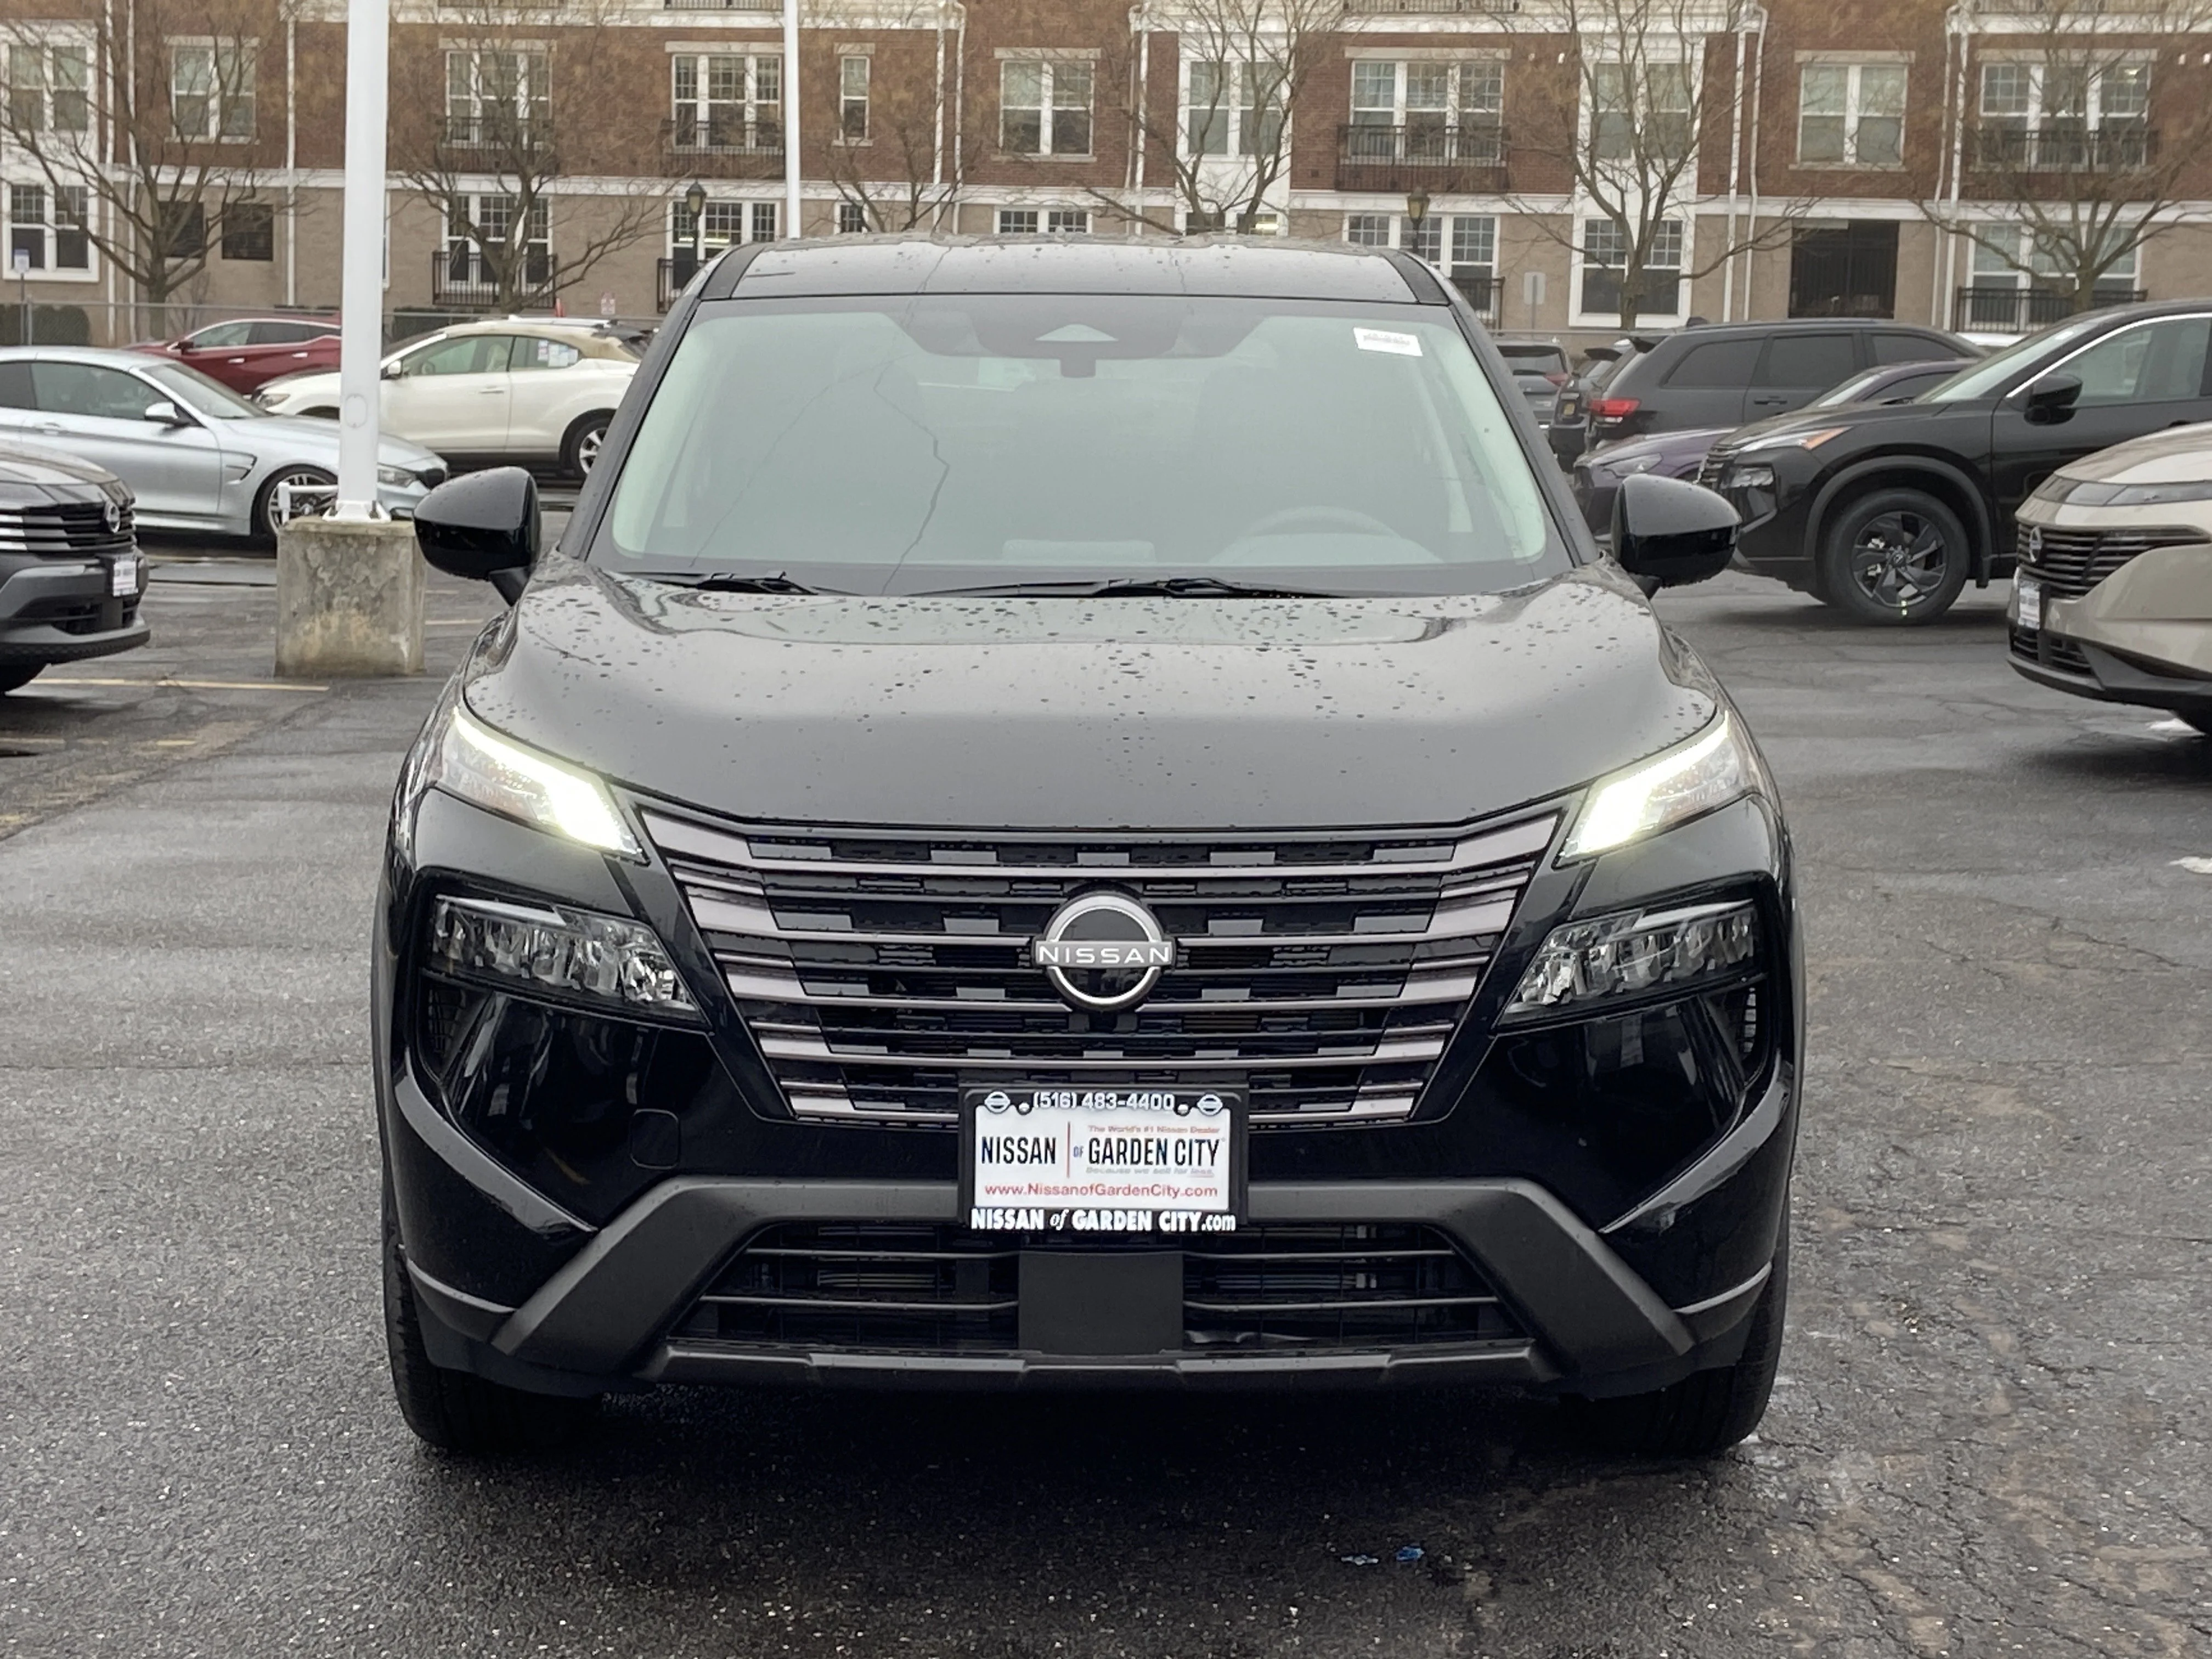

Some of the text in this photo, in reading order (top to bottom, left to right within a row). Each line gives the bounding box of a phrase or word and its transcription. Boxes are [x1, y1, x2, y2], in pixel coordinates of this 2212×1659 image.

[1039, 945, 1169, 963] NISSAN
[1033, 1091, 1175, 1110] (516) 483-4400
[981, 1136, 1057, 1165] NISSAN
[1088, 1137, 1168, 1166] GARDEN
[1174, 1138, 1220, 1166] CITY
[985, 1183, 1218, 1199] www.NissanofGardenCity.com
[971, 1207, 1237, 1232] NISSAN of GARDEN CITY.com
